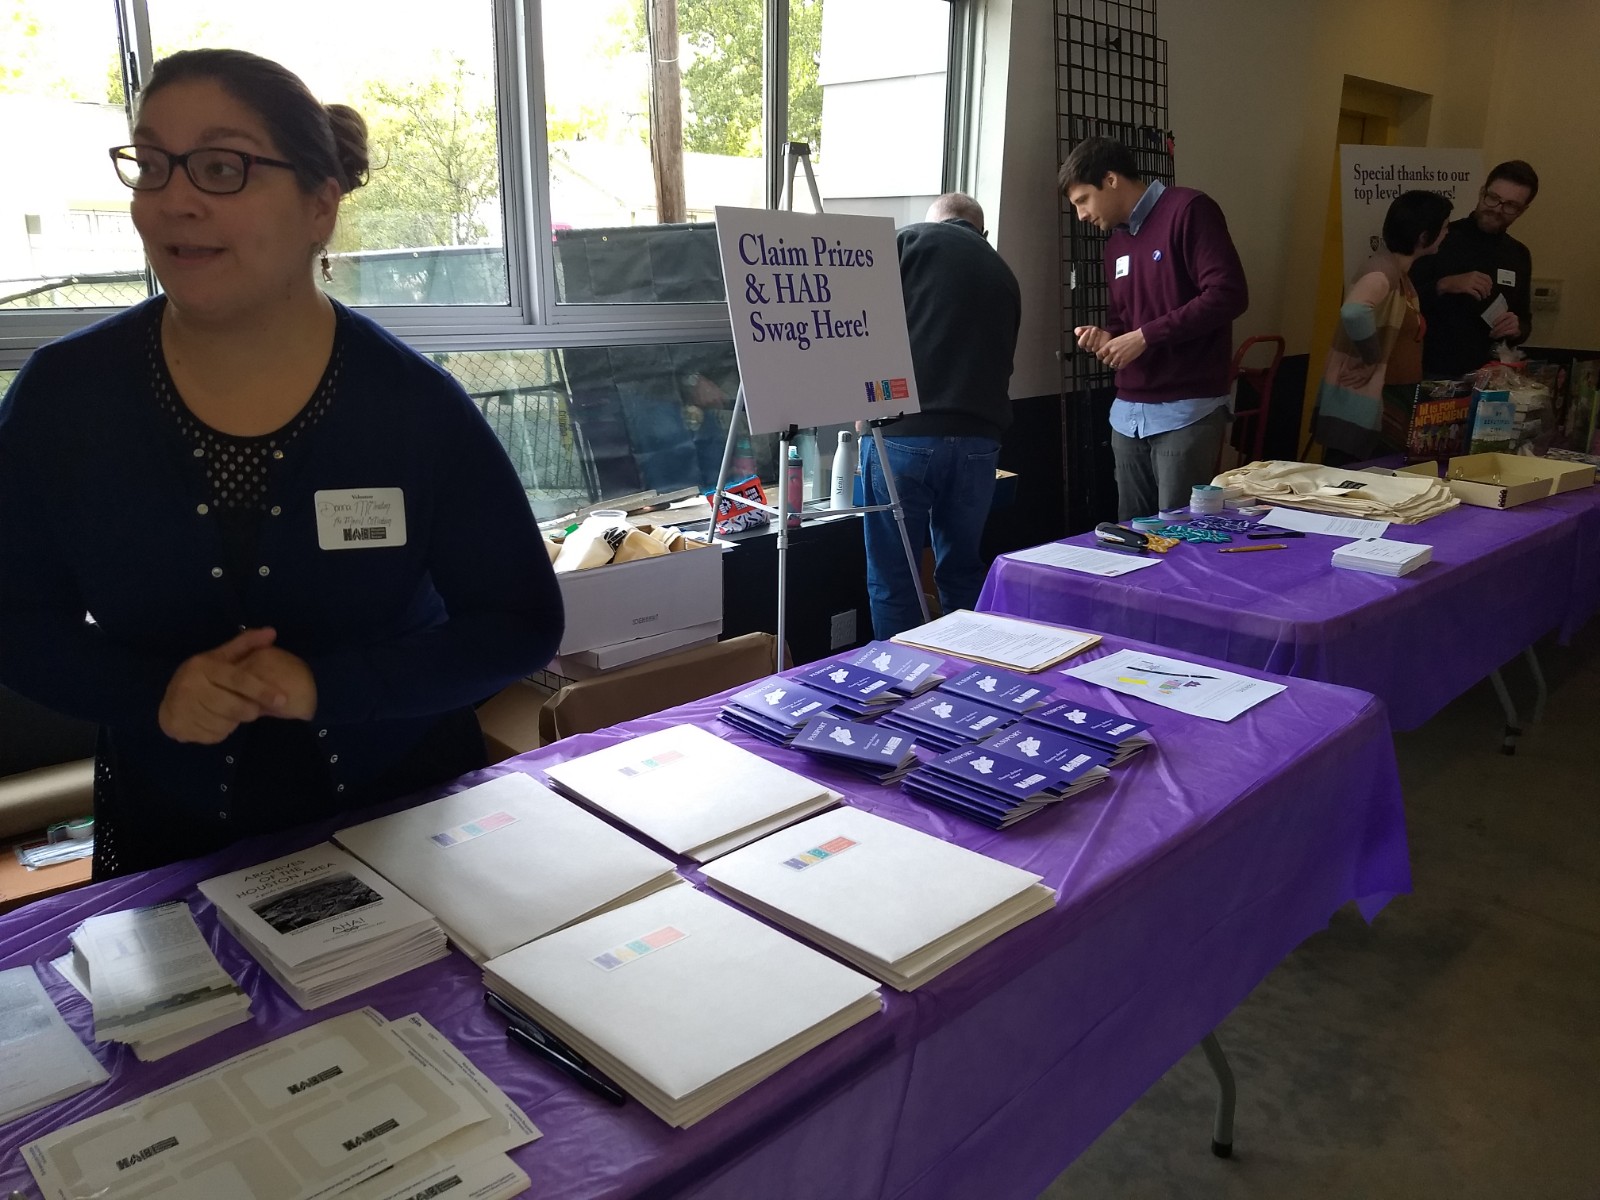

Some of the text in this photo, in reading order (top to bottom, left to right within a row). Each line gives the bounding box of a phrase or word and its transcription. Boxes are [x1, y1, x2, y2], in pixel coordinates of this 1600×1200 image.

[1354, 163, 1470, 186] Special thanks to our
[1354, 186, 1373, 205] top
[1375, 184, 1401, 199] level
[738, 233, 874, 268] Claim Prizes
[745, 272, 831, 304] & HAB
[750, 309, 869, 350] Swag Here!
[1419, 403, 1429, 416] M
[836, 476, 844, 495] Menil
[235, 873, 299, 899] HOUSTON
[303, 862, 337, 876] AREA
[244, 860, 305, 882] ARCHIVES
[259, 867, 302, 883] OF THE
